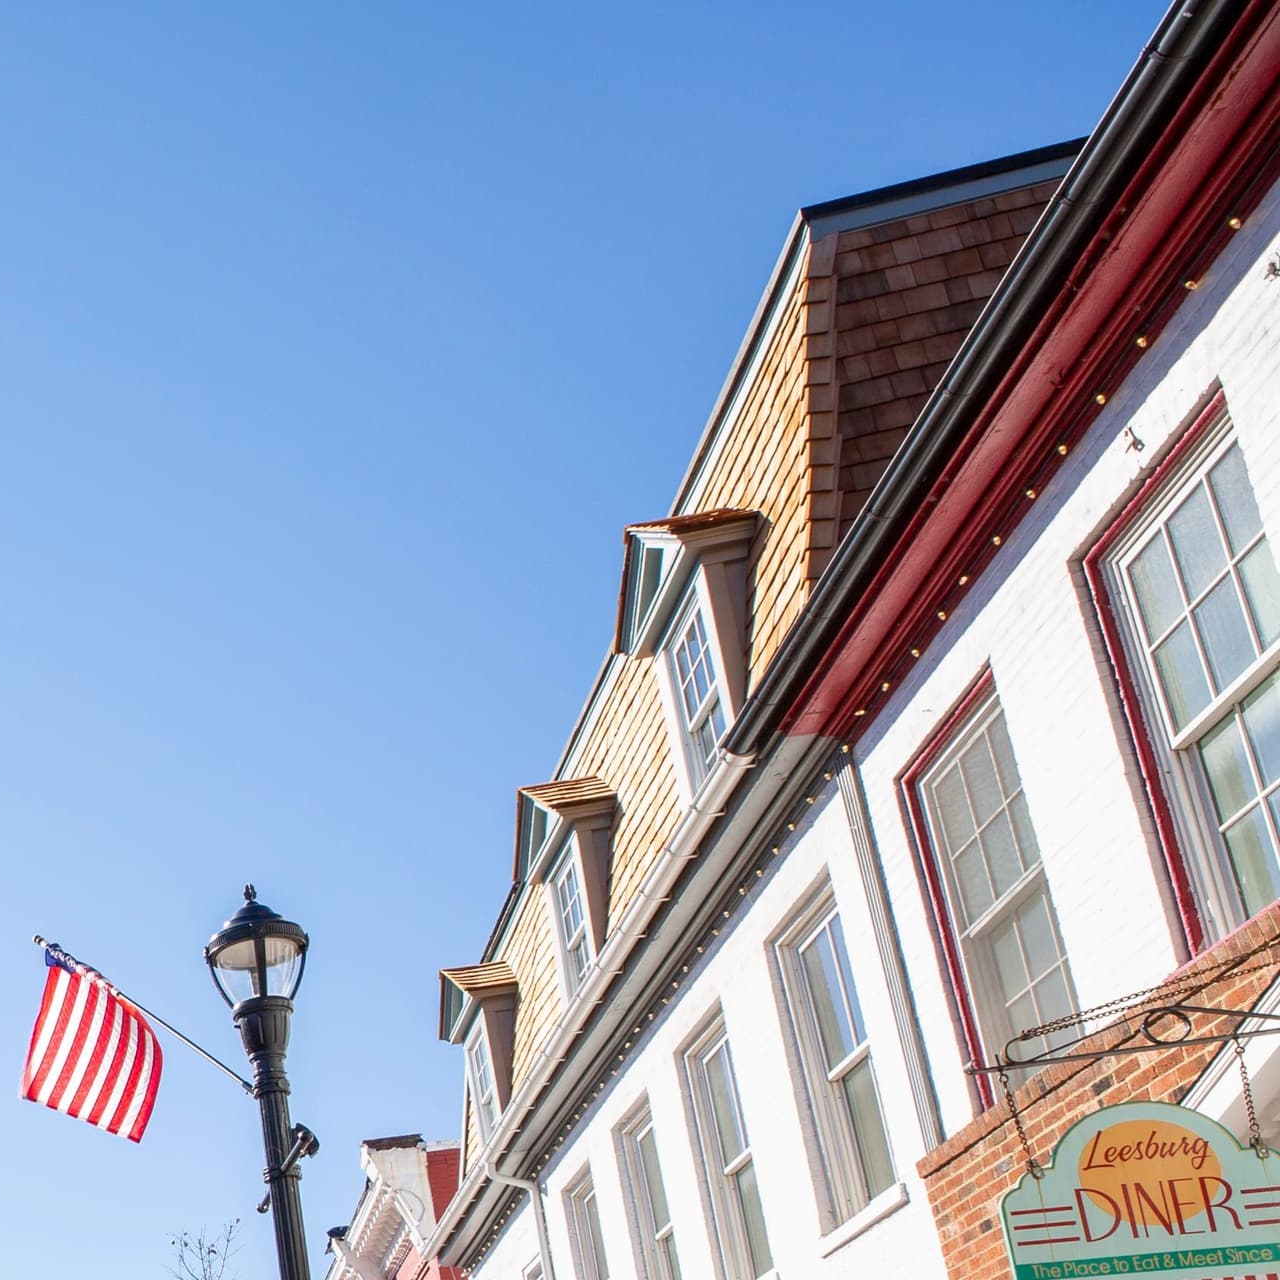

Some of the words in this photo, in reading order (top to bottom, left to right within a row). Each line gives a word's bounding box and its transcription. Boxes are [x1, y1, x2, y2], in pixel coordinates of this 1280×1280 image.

[1083, 1130, 1211, 1171] Leesburg
[1074, 1176, 1244, 1243] DINER
[1032, 1264, 1060, 1279] The
[1064, 1261, 1110, 1277] Place
[1113, 1258, 1130, 1273] to
[1133, 1256, 1160, 1272] Eat
[1163, 1254, 1176, 1268] &
[1179, 1250, 1225, 1267] Meet
[1227, 1247, 1273, 1263] Since
